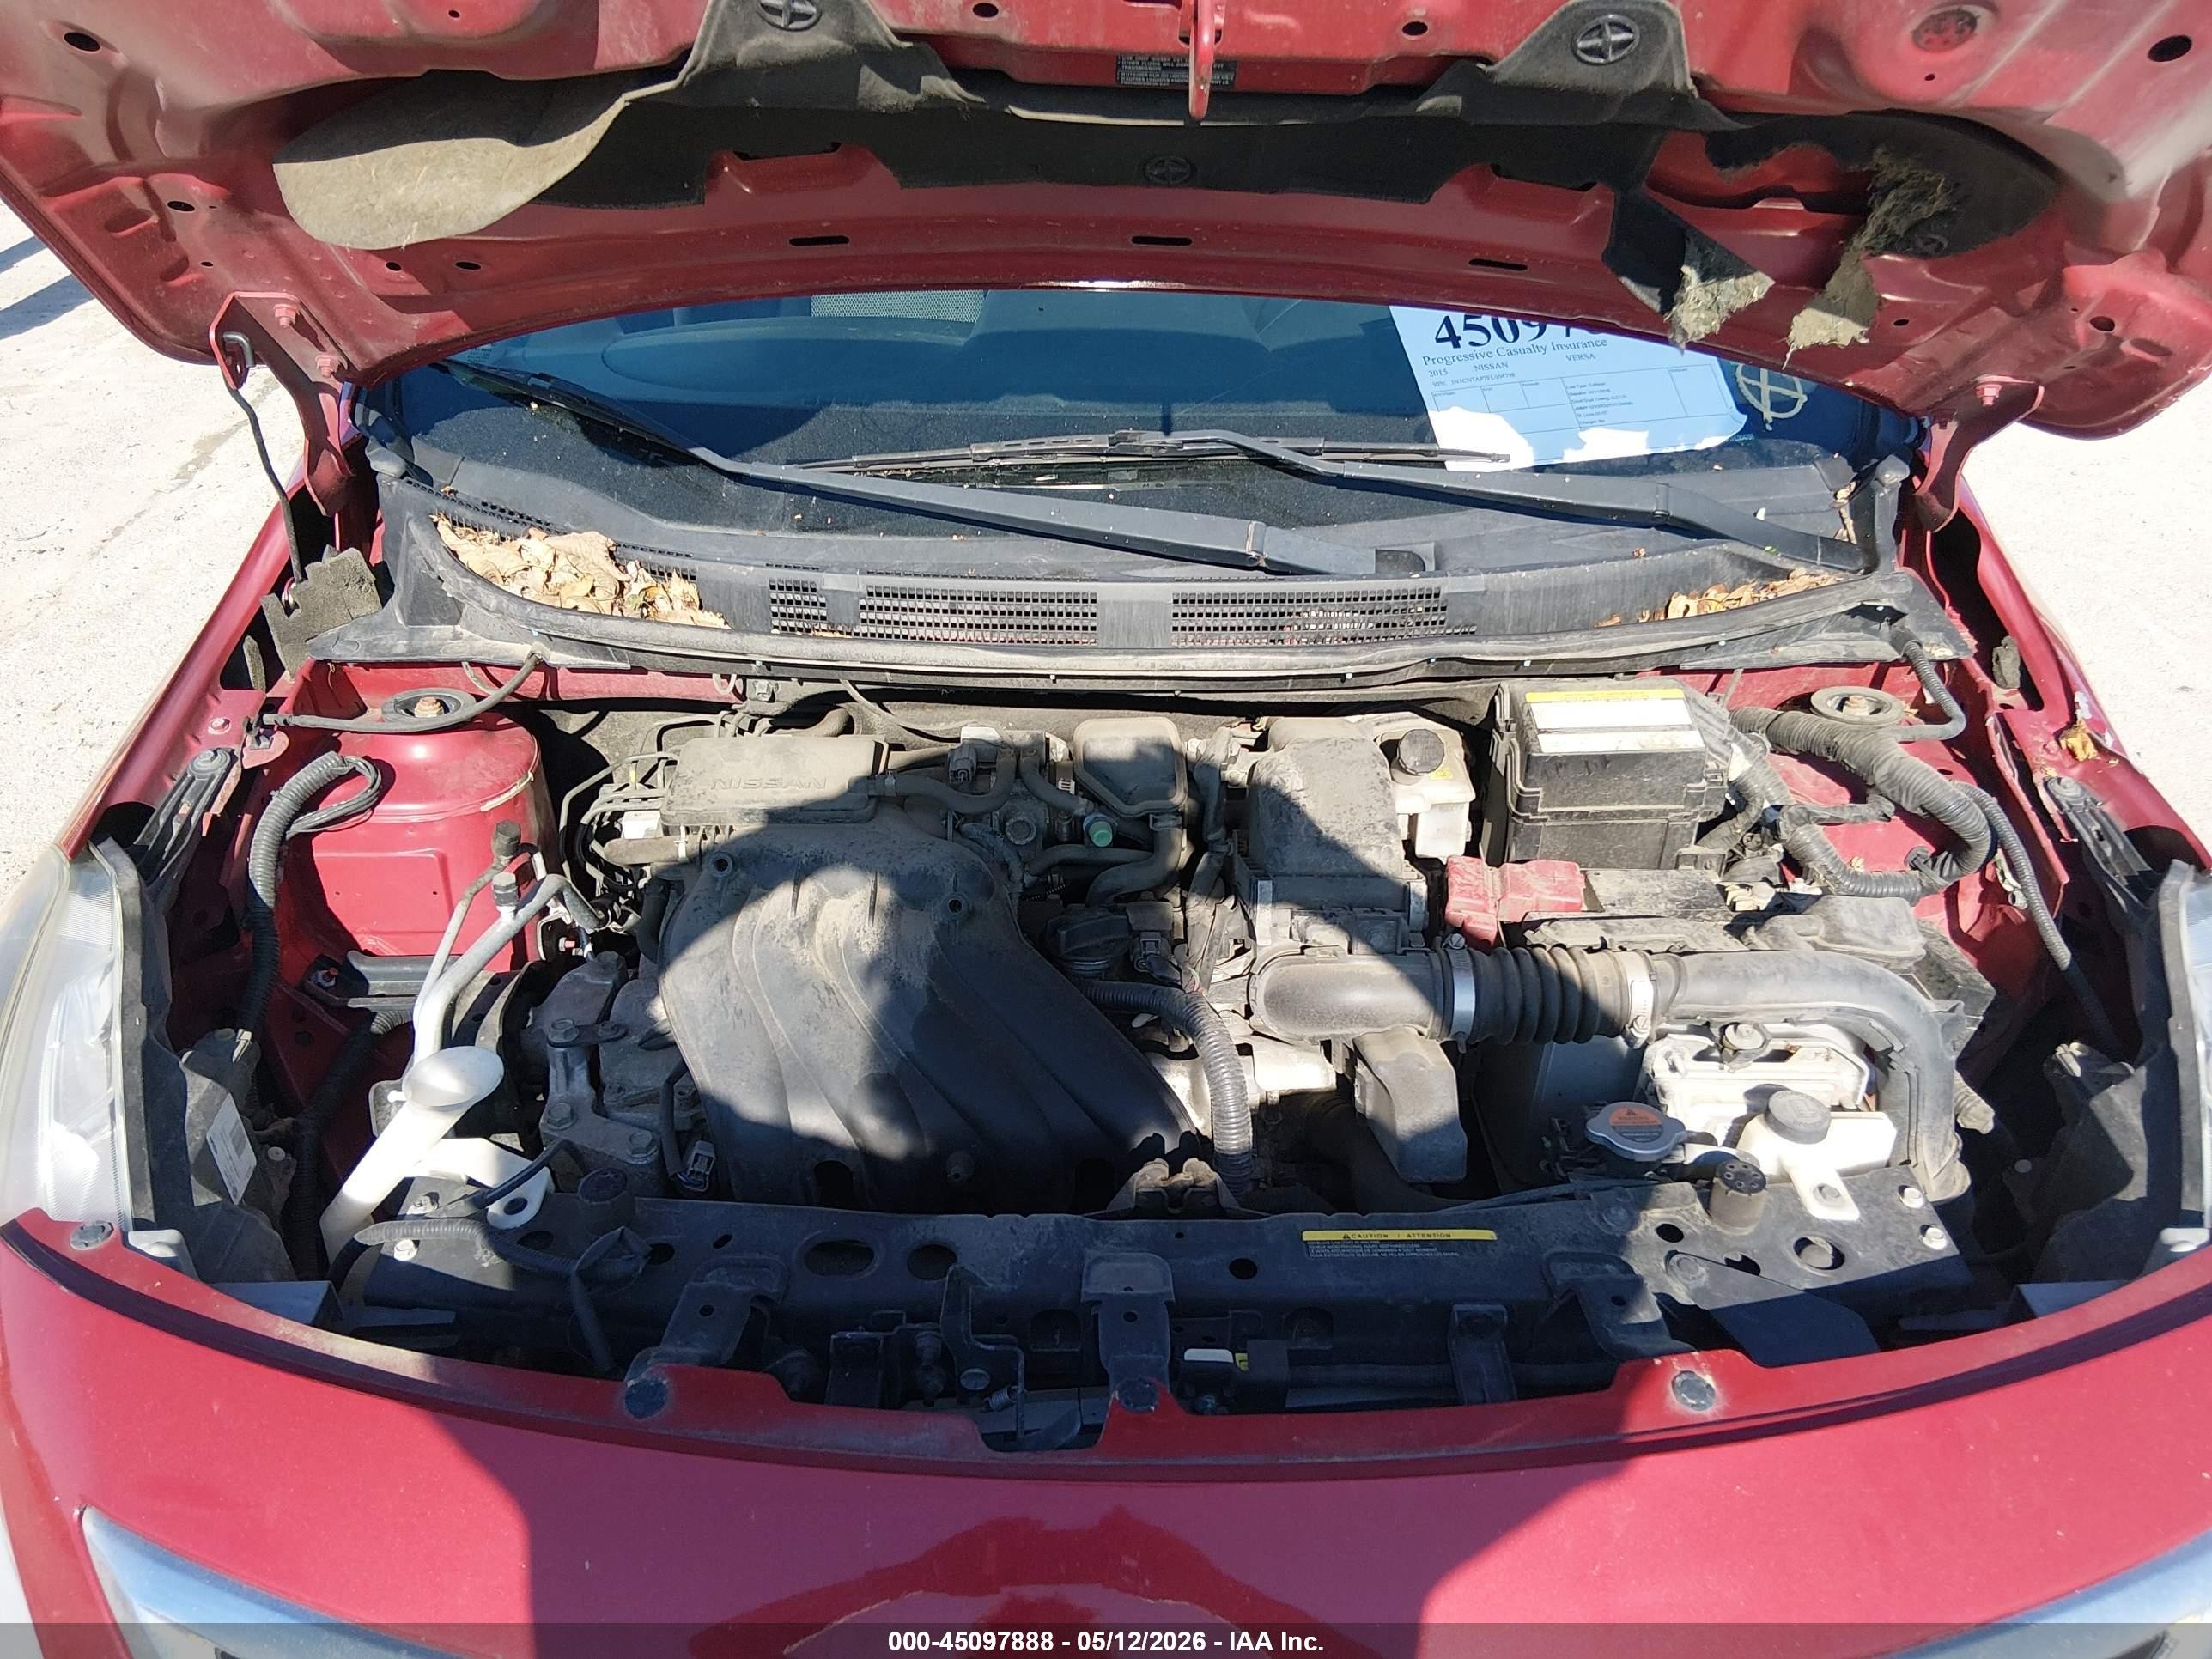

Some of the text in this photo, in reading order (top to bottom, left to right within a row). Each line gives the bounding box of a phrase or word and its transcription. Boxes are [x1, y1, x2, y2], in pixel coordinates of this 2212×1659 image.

[1422, 338, 1608, 366] Progressive Casualty Insurance
[1429, 353, 1596, 378] 2015 NISSAN VERSA
[710, 776, 827, 791] NISSAN
